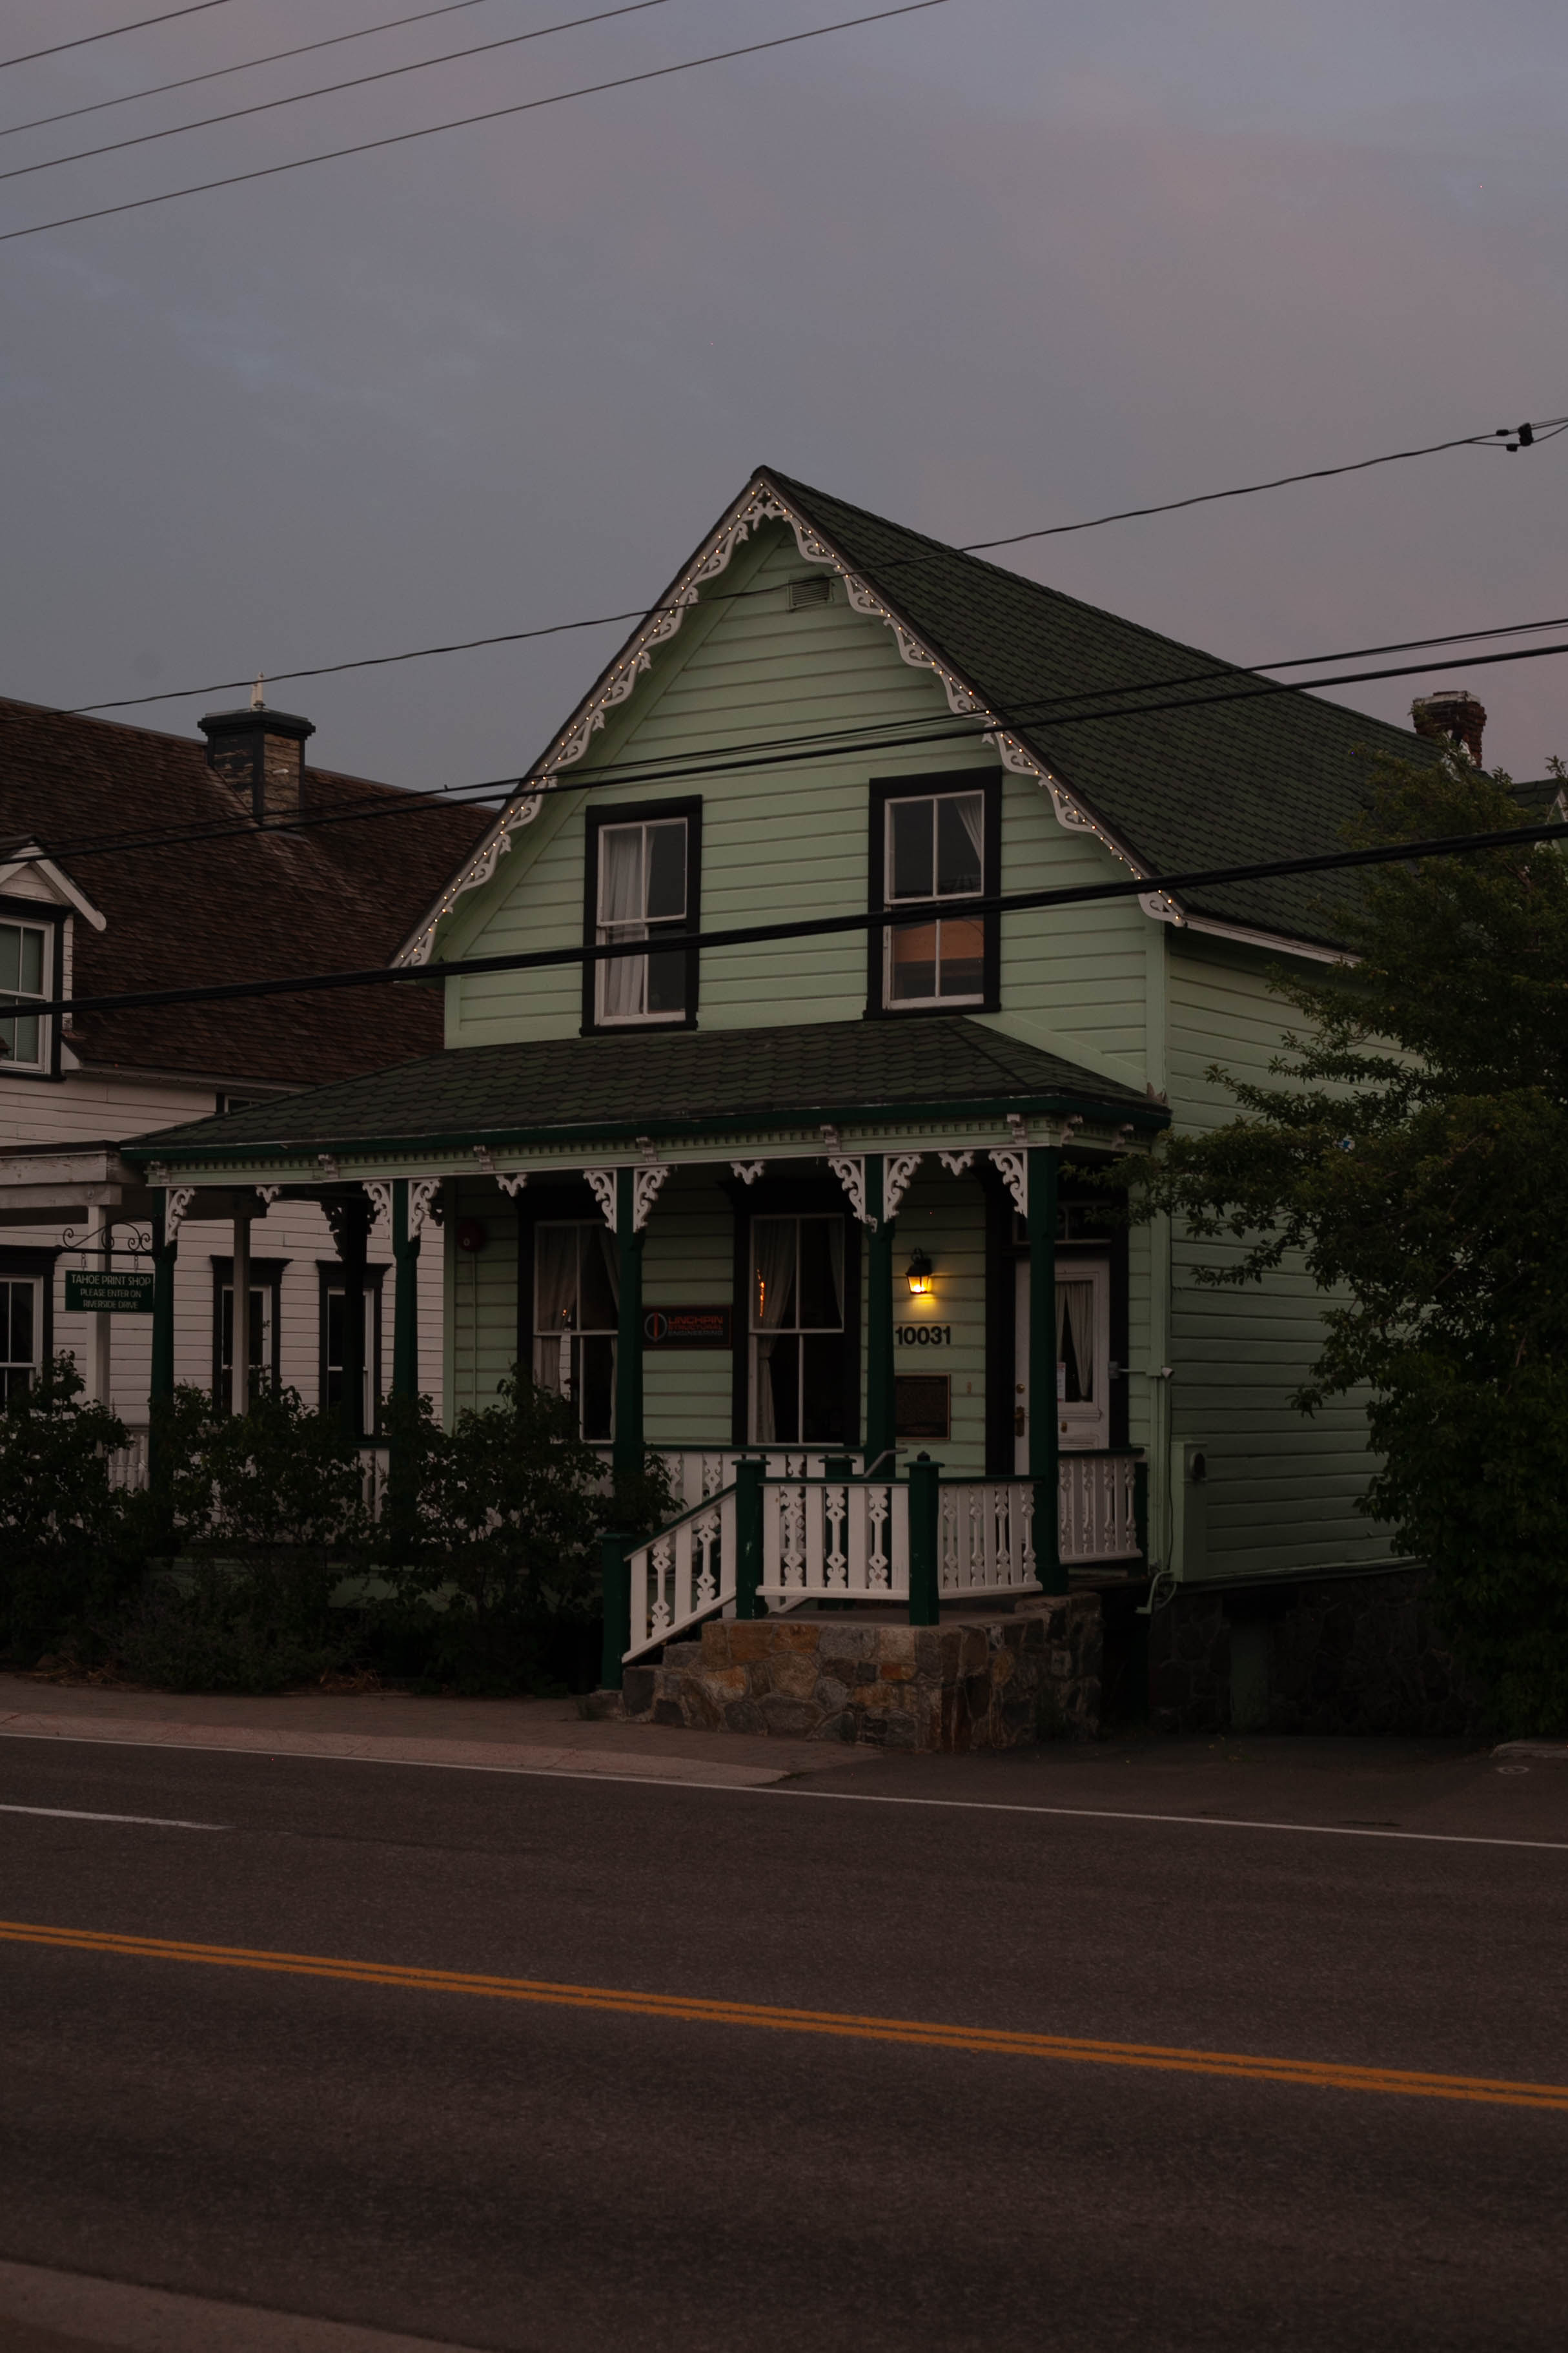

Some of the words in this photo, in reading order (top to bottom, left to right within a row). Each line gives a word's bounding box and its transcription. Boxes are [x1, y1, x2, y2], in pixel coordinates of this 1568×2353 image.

[71, 1274, 100, 1285] TAHOE
[101, 1275, 125, 1286] PRINT
[128, 1276, 151, 1287] SHOP
[80, 1288, 105, 1297] PLEASE
[107, 1289, 129, 1298] ENTER
[130, 1290, 142, 1298] ON
[83, 1299, 117, 1308] RIVERSIDE
[118, 1300, 139, 1310] DRIVE
[895, 1326, 951, 1345] 10031
